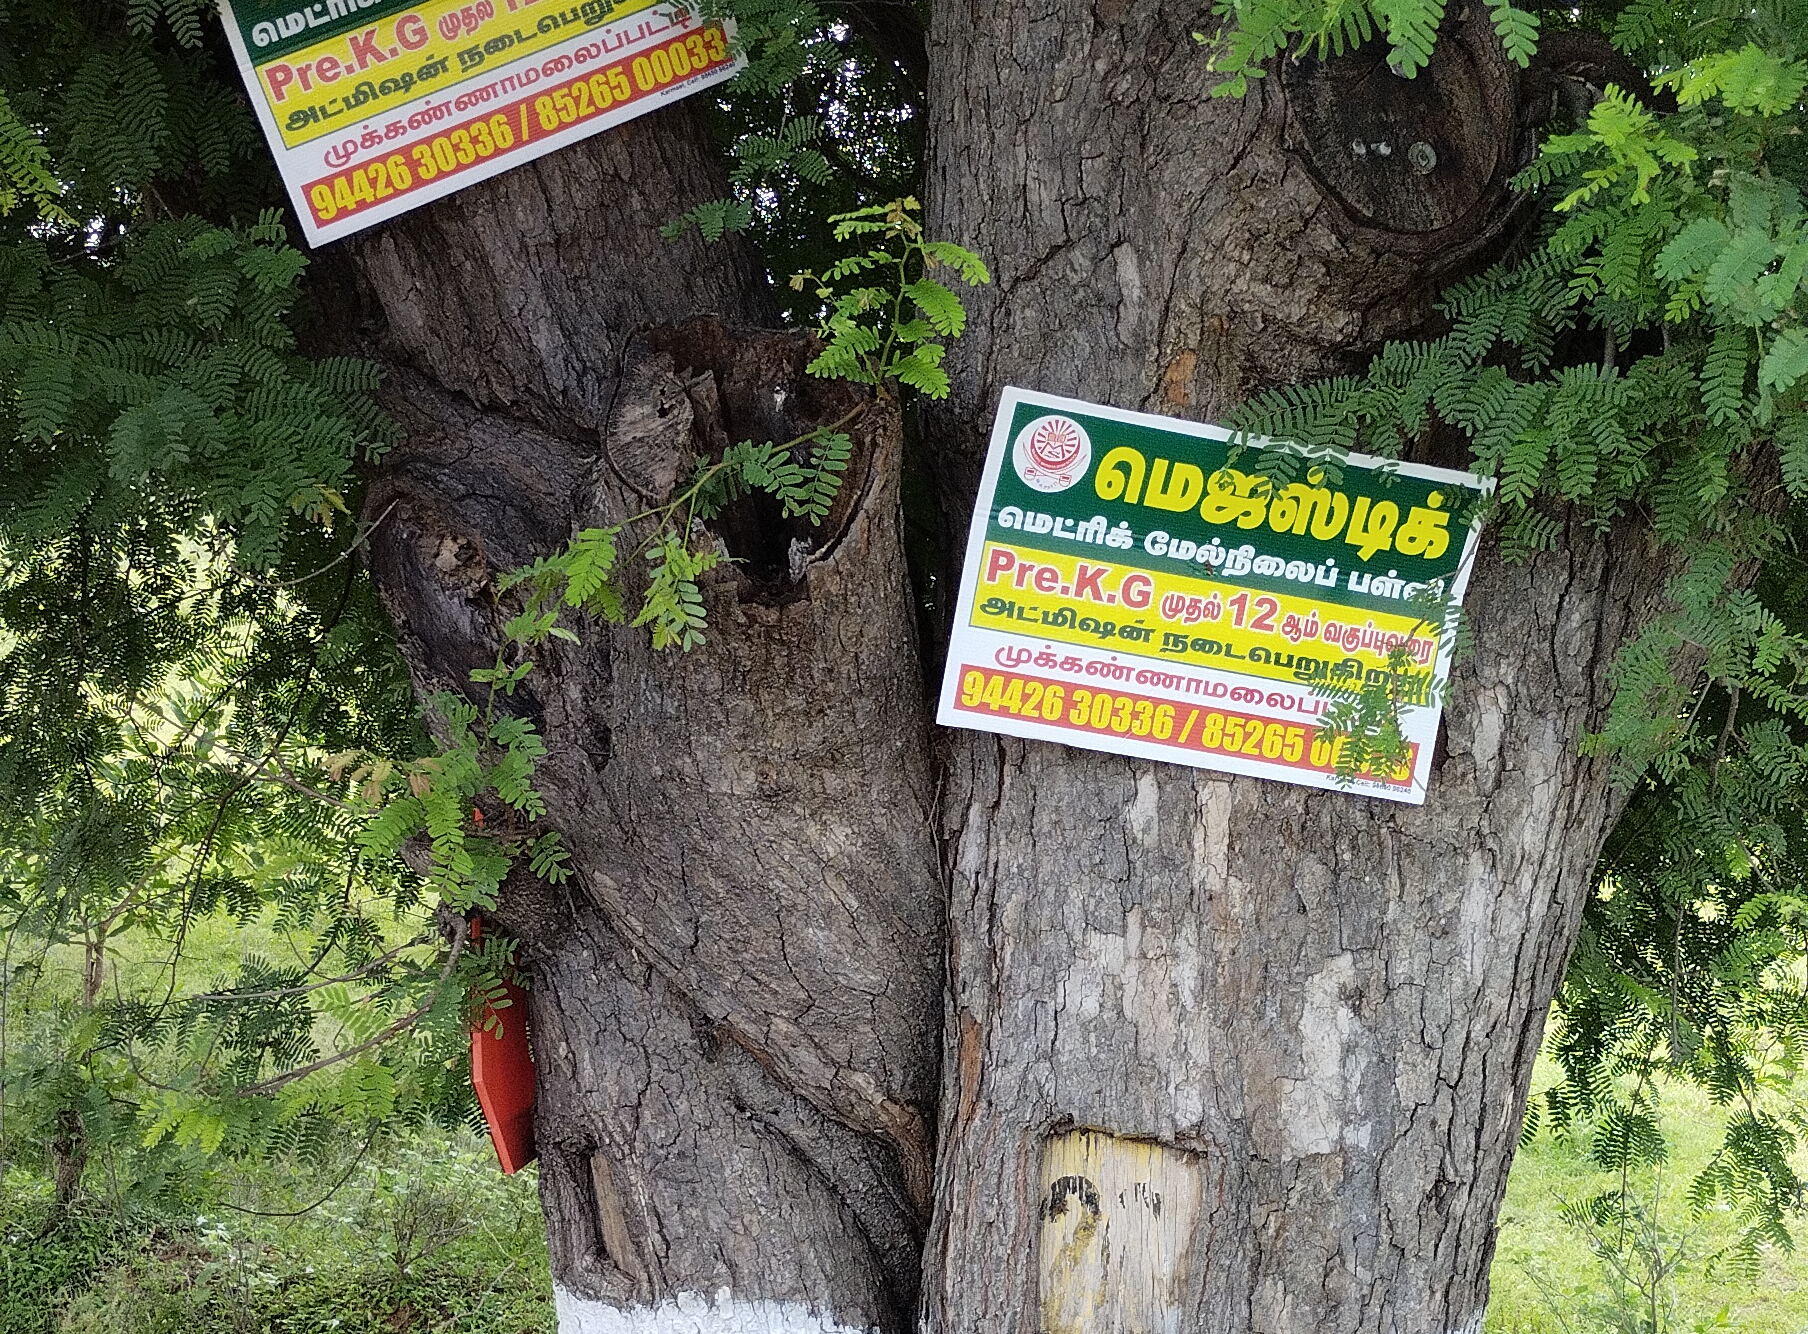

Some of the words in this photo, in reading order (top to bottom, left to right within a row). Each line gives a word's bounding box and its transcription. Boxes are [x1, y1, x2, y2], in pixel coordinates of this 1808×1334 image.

[264, 12, 430, 103] Pre.K.G
[284, 54, 450, 134] அட்மிஷன்
[323, 6, 693, 169] முக்கண்ணாமலைப்பட்டி
[310, 160, 407, 221] 94426
[415, 112, 515, 181] 30336
[519, 106, 532, 142] /
[536, 71, 634, 133] 85265
[632, 27, 727, 91] 00033
[997, 505, 1133, 550] மெட்ரிக்
[1144, 528, 1339, 587] மேல்நிலைப்
[1094, 446, 1451, 562] மெஜஸ்டிக்
[980, 596, 1156, 643] அட்மிஷன்
[985, 548, 1153, 609] Pre.K.G
[1161, 592, 1222, 623] முதல்
[1229, 593, 1280, 632] 12
[1282, 612, 1319, 643] ஆம்
[961, 670, 1065, 721] 94426
[1069, 689, 1177, 741] 30336
[1177, 709, 1200, 744] /
[1202, 712, 1306, 763] 85265
